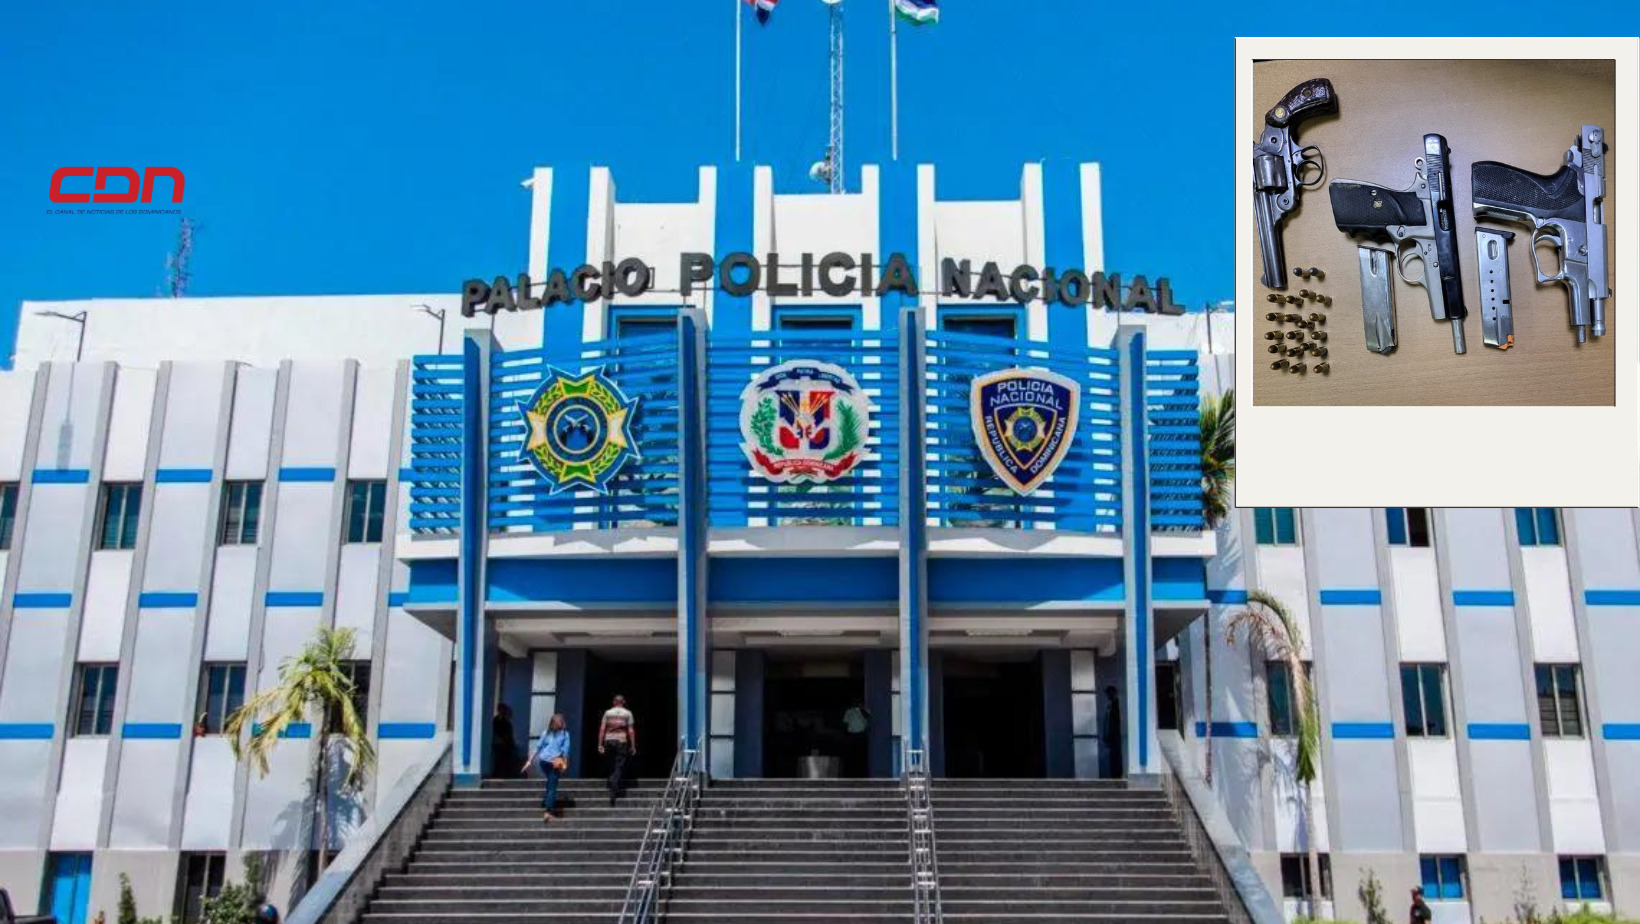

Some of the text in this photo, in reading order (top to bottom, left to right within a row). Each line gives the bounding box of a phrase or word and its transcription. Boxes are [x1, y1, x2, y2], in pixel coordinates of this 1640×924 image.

[461, 251, 1186, 318] PALACIO POLICIA NACIONAL
[990, 391, 1063, 410] NACIONAL
[997, 381, 1054, 396] POLICIA
[985, 415, 1067, 474] REPUBLICA DOMINICANA
